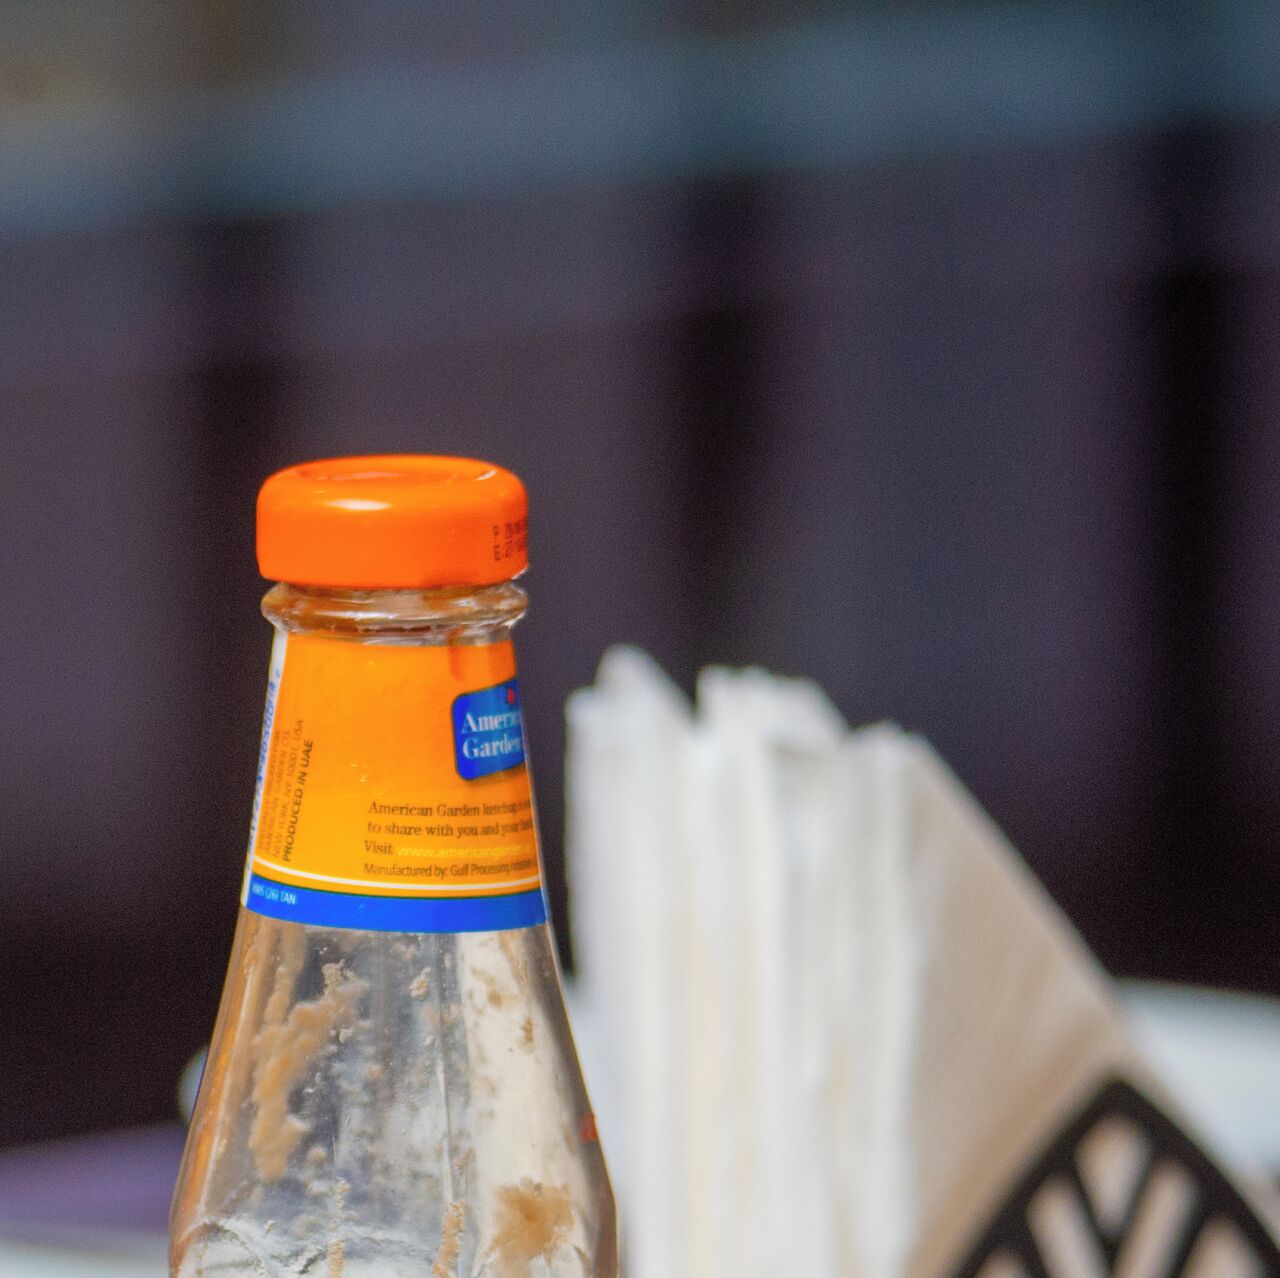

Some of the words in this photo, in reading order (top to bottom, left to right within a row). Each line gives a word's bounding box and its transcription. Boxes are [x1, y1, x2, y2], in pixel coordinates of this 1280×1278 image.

[293, 719, 304, 741] USA
[300, 738, 314, 767] UAE
[297, 770, 307, 785] IN
[367, 800, 433, 817] American
[436, 803, 480, 817] Garden
[282, 788, 304, 862] PRODUCED
[367, 821, 382, 834] to
[384, 822, 422, 836] share
[425, 823, 454, 837] with
[456, 826, 479, 840] you
[363, 862, 432, 877] Manufactured
[450, 864, 470, 877] Gulf
